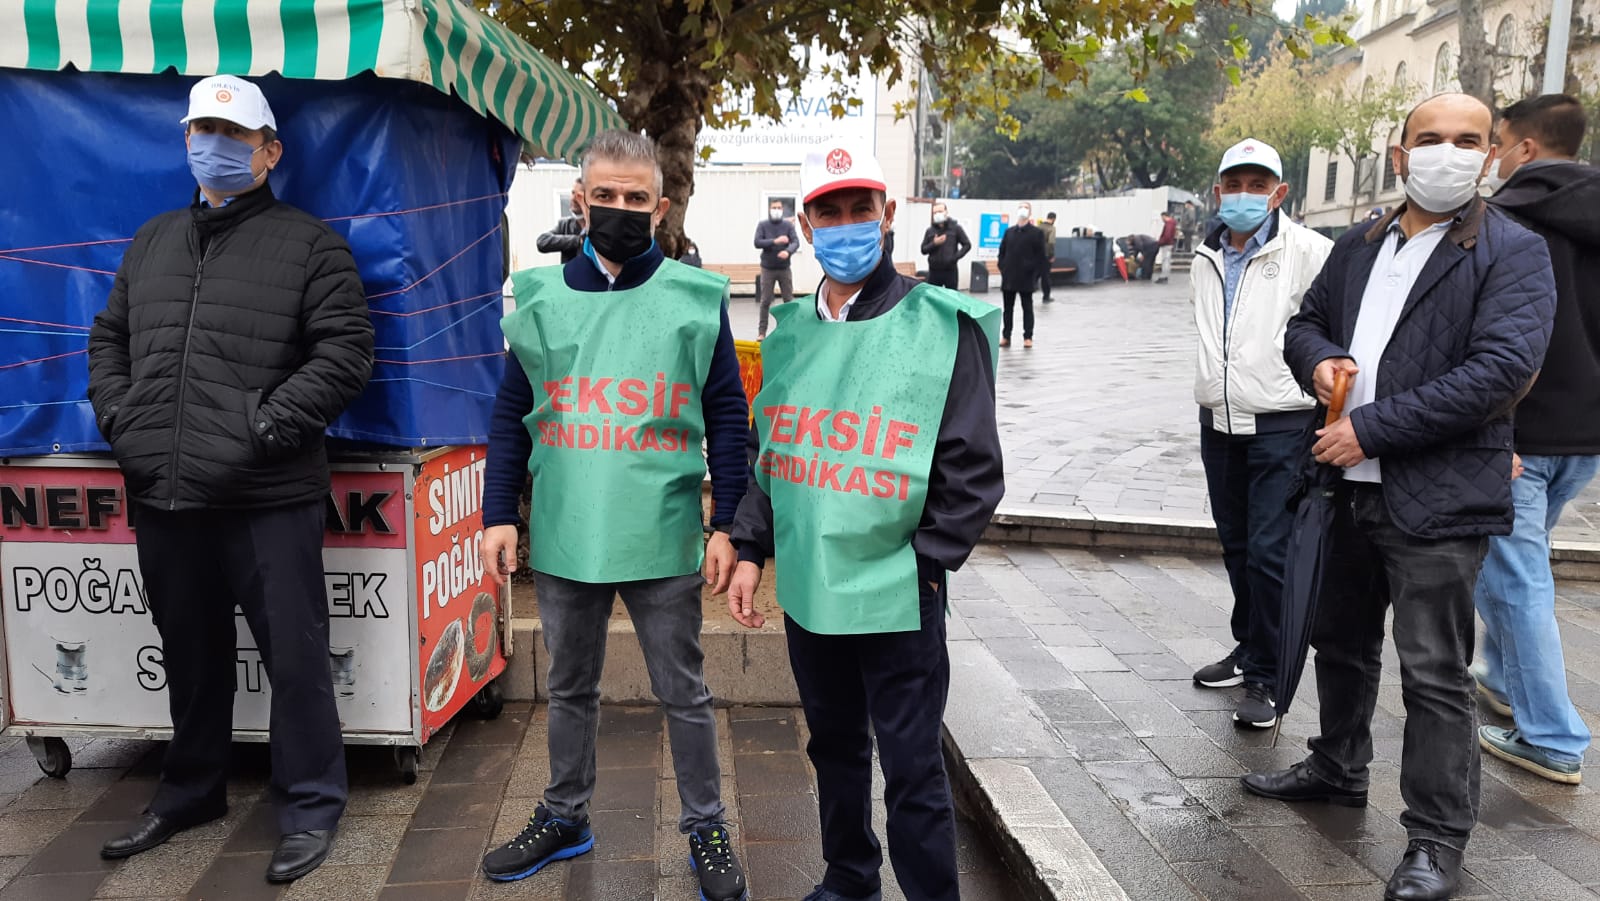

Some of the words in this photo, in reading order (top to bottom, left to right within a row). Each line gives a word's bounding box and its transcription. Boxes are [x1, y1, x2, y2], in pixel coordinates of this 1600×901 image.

[537, 372, 691, 418] TEKSİF
[537, 419, 689, 452] SENDİKASI
[763, 405, 919, 459] TEKSİF
[429, 453, 486, 536] SİMİT
[13, 558, 150, 615] POĞA
[323, 572, 389, 618] EK
[422, 532, 485, 619] POĞAÇ
